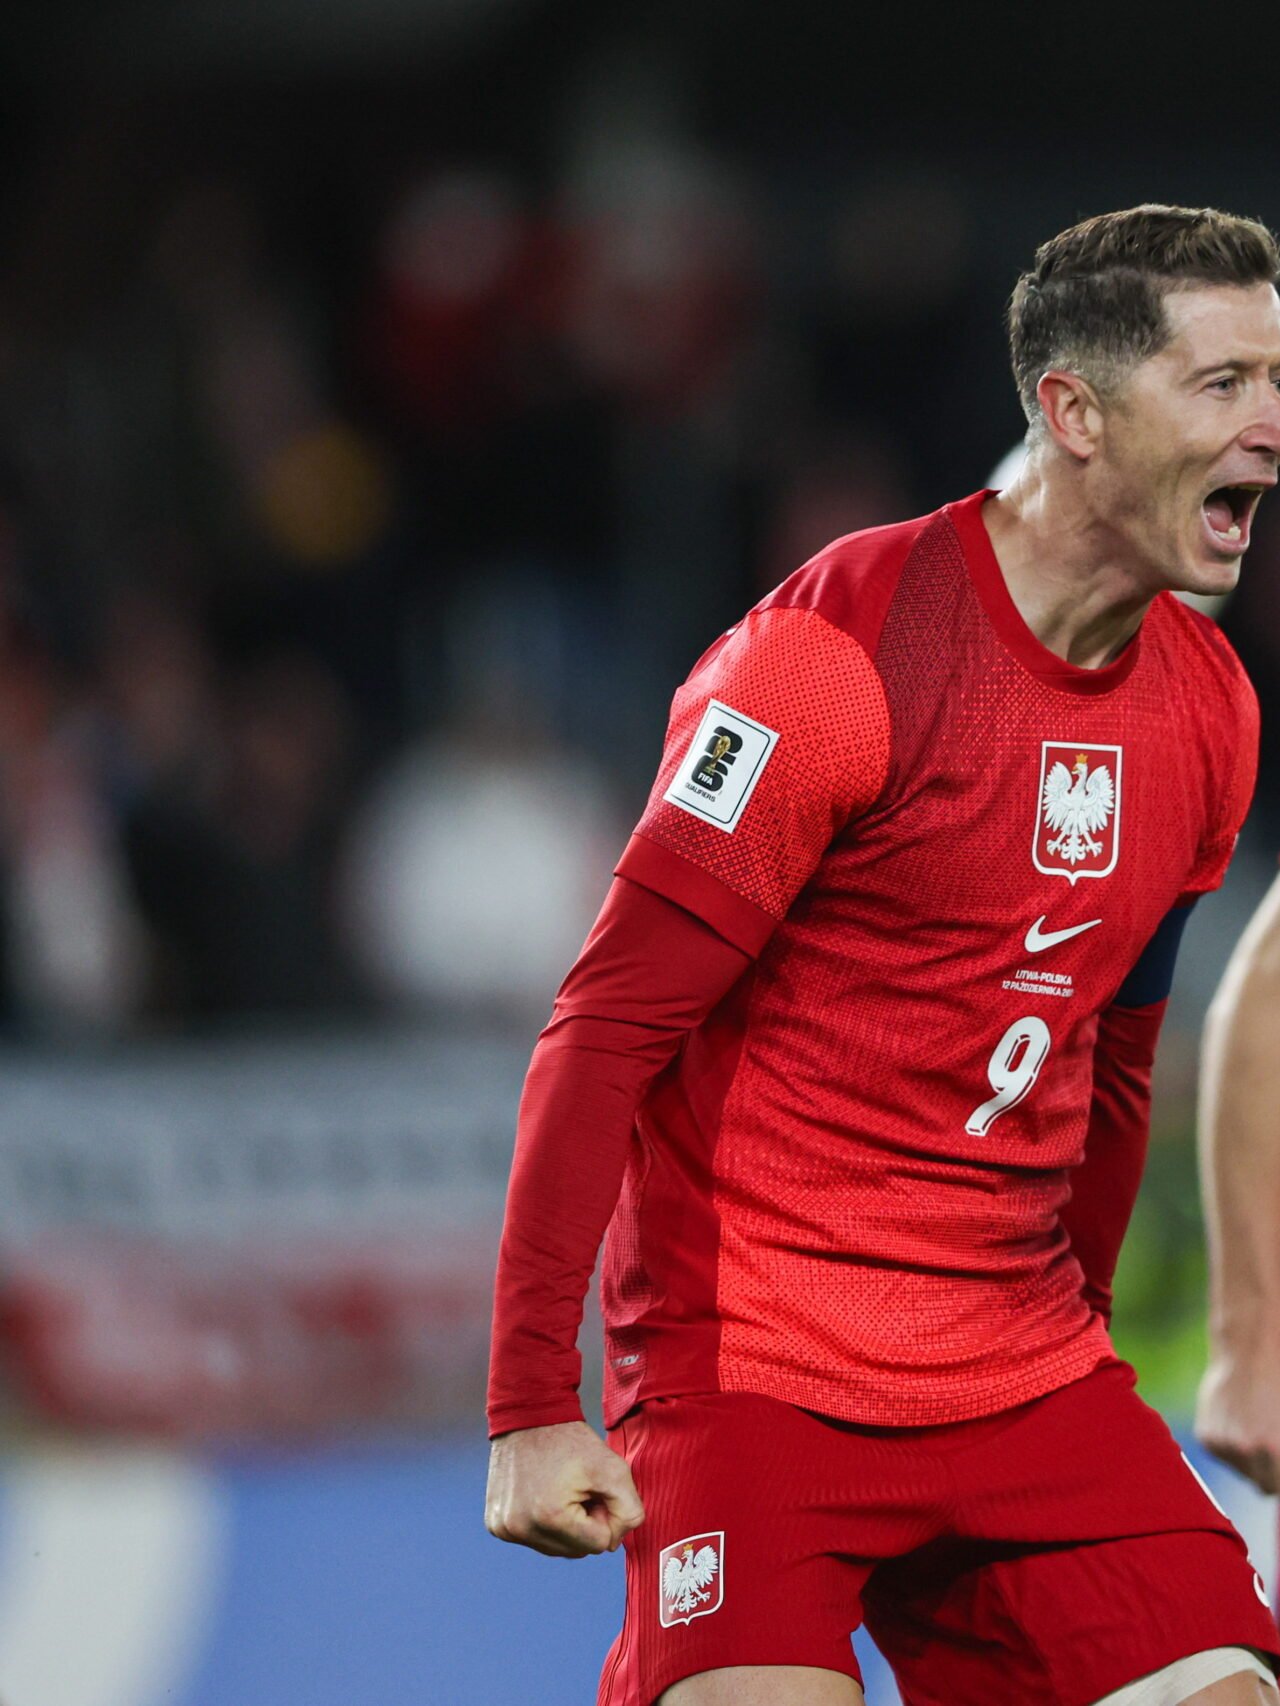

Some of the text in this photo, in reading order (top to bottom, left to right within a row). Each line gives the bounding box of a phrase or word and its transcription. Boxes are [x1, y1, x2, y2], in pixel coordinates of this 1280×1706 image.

[697, 772, 714, 786] FIFA
[1015, 969, 1072, 985] LITWA-POLSKA
[964, 1016, 1051, 1137] 9
